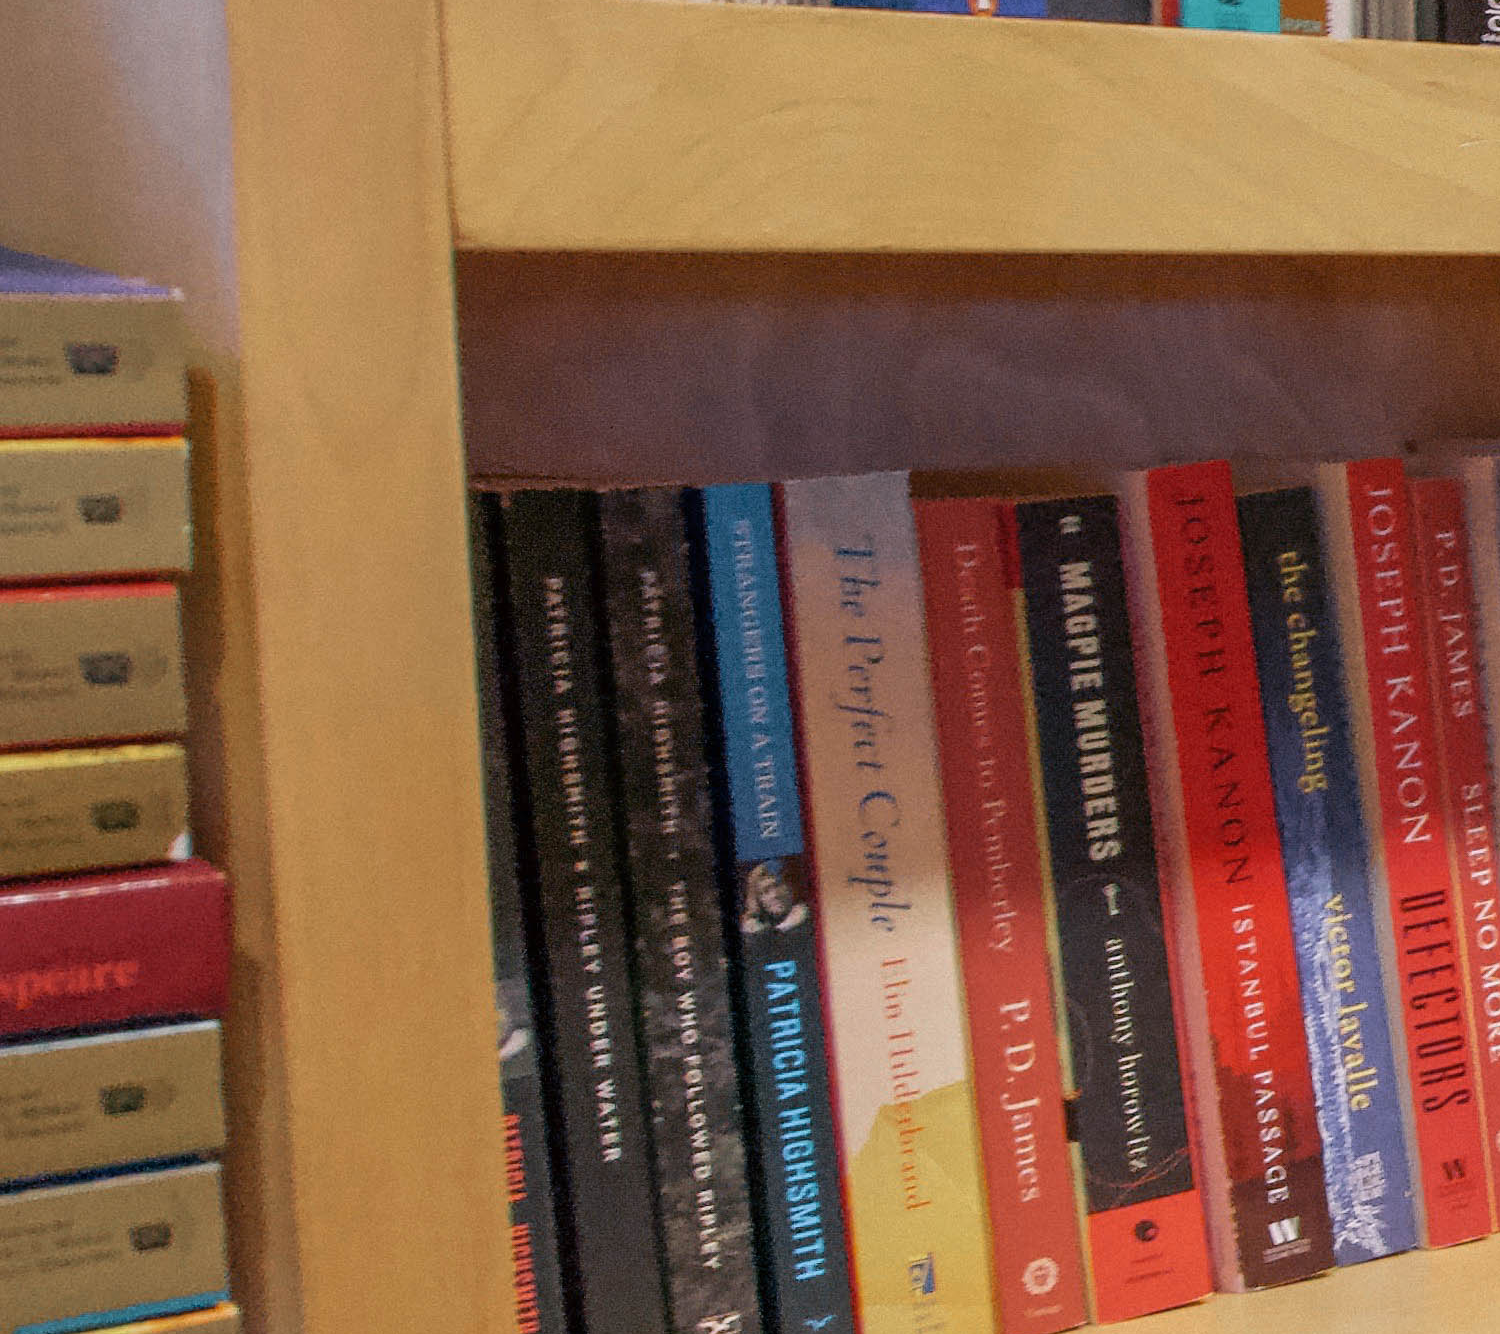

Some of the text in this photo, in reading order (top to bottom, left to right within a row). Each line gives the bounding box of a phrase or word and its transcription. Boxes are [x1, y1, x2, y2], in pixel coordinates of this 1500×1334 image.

[835, 541, 914, 935] The Perfect Couple
[1059, 559, 1148, 1174] MAGPIE MURDERS anthony horowitz
[1277, 548, 1375, 1114] the changeling victor lavalle
[764, 960, 828, 1281] PATRICIA HIGHSMITH
